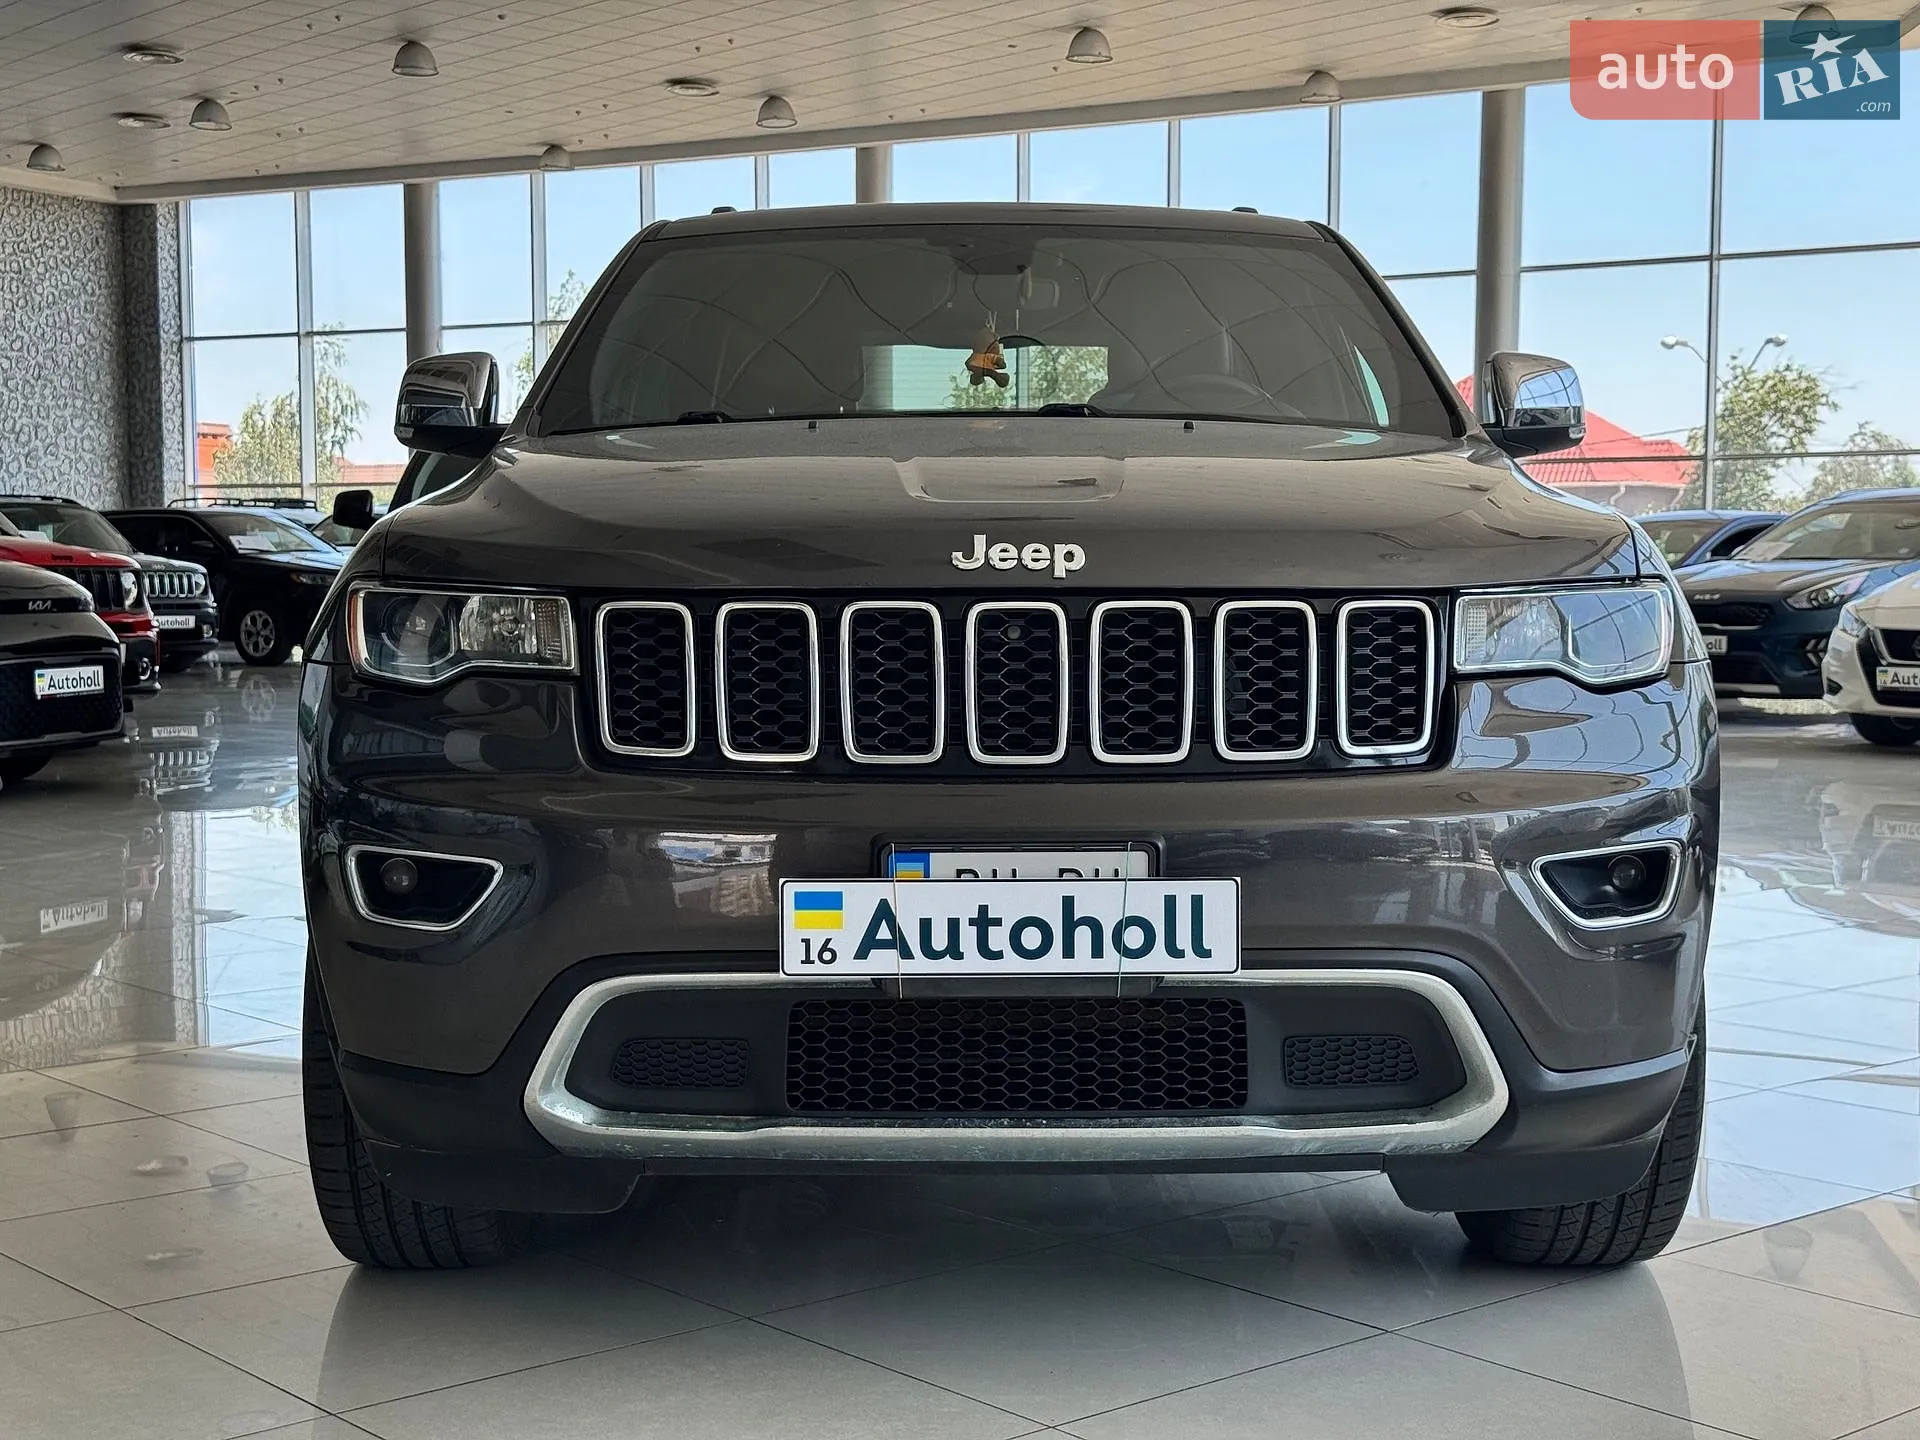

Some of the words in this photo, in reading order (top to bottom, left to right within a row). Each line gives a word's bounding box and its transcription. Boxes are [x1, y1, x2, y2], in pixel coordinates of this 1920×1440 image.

[951, 533, 1086, 579] Jeep
[48, 669, 101, 691] Autoholl
[1890, 672, 1920, 686] Aut
[800, 938, 837, 965] 16
[853, 894, 1212, 960] Autoholl
